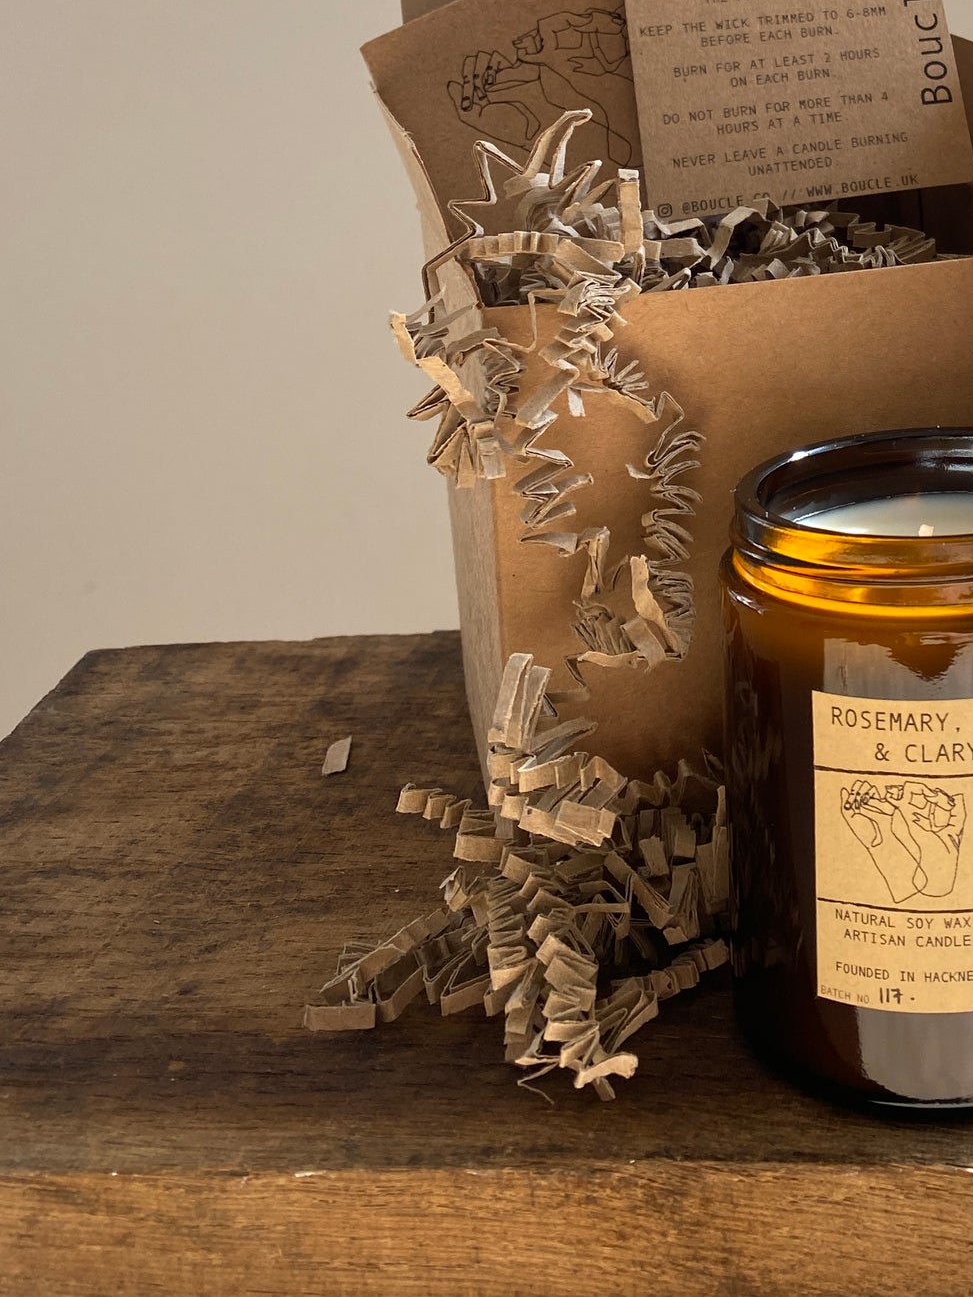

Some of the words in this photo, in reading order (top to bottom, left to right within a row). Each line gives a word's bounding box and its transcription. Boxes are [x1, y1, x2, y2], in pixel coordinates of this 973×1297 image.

[639, 24, 672, 37] KEEP
[682, 22, 706, 33] THE
[715, 18, 749, 30] WICK
[758, 12, 814, 26] TRIMMED
[823, 10, 838, 20] TO
[846, 6, 886, 19] 6-8MM
[701, 34, 750, 47] BEFORE
[760, 30, 792, 42] EACH
[801, 26, 839, 38] BURN.
[673, 65, 707, 78] BURN
[716, 62, 740, 73] FOR
[750, 59, 765, 69] AT
[774, 54, 814, 68] LEAST
[825, 53, 832, 63] 2
[840, 48, 881, 61] HOURS
[731, 77, 747, 88] ON
[756, 72, 789, 85] EACH
[663, 113, 680, 125] DO
[689, 109, 713, 122] NOT
[723, 105, 757, 119] BURN
[765, 101, 790, 113] FOR
[799, 96, 831, 110] MORE
[840, 93, 873, 105] THAN
[881, 92, 889, 101] 4
[716, 121, 759, 136] HOURS
[768, 118, 783, 129] AT
[793, 115, 801, 126] A
[672, 154, 716, 169] NEVER
[724, 147, 766, 163] LEAVE
[776, 146, 784, 156] A
[792, 140, 842, 155] CANDLE
[851, 132, 909, 148] BURNING
[806, 174, 919, 199] WWW.BOUCLE.UK
[830, 706, 961, 733] ROSEMARY,
[874, 742, 890, 762] &
[835, 909, 896, 928] NATURAL
[906, 917, 934, 930] SOY
[943, 917, 971, 929] WAX
[843, 929, 905, 947] ARTISAN
[916, 935, 971, 948] CANDLE
[835, 962, 890, 981] FOUNDED
[900, 970, 915, 982] IN
[820, 984, 851, 1001] BATCH
[857, 994, 870, 1005] NO
